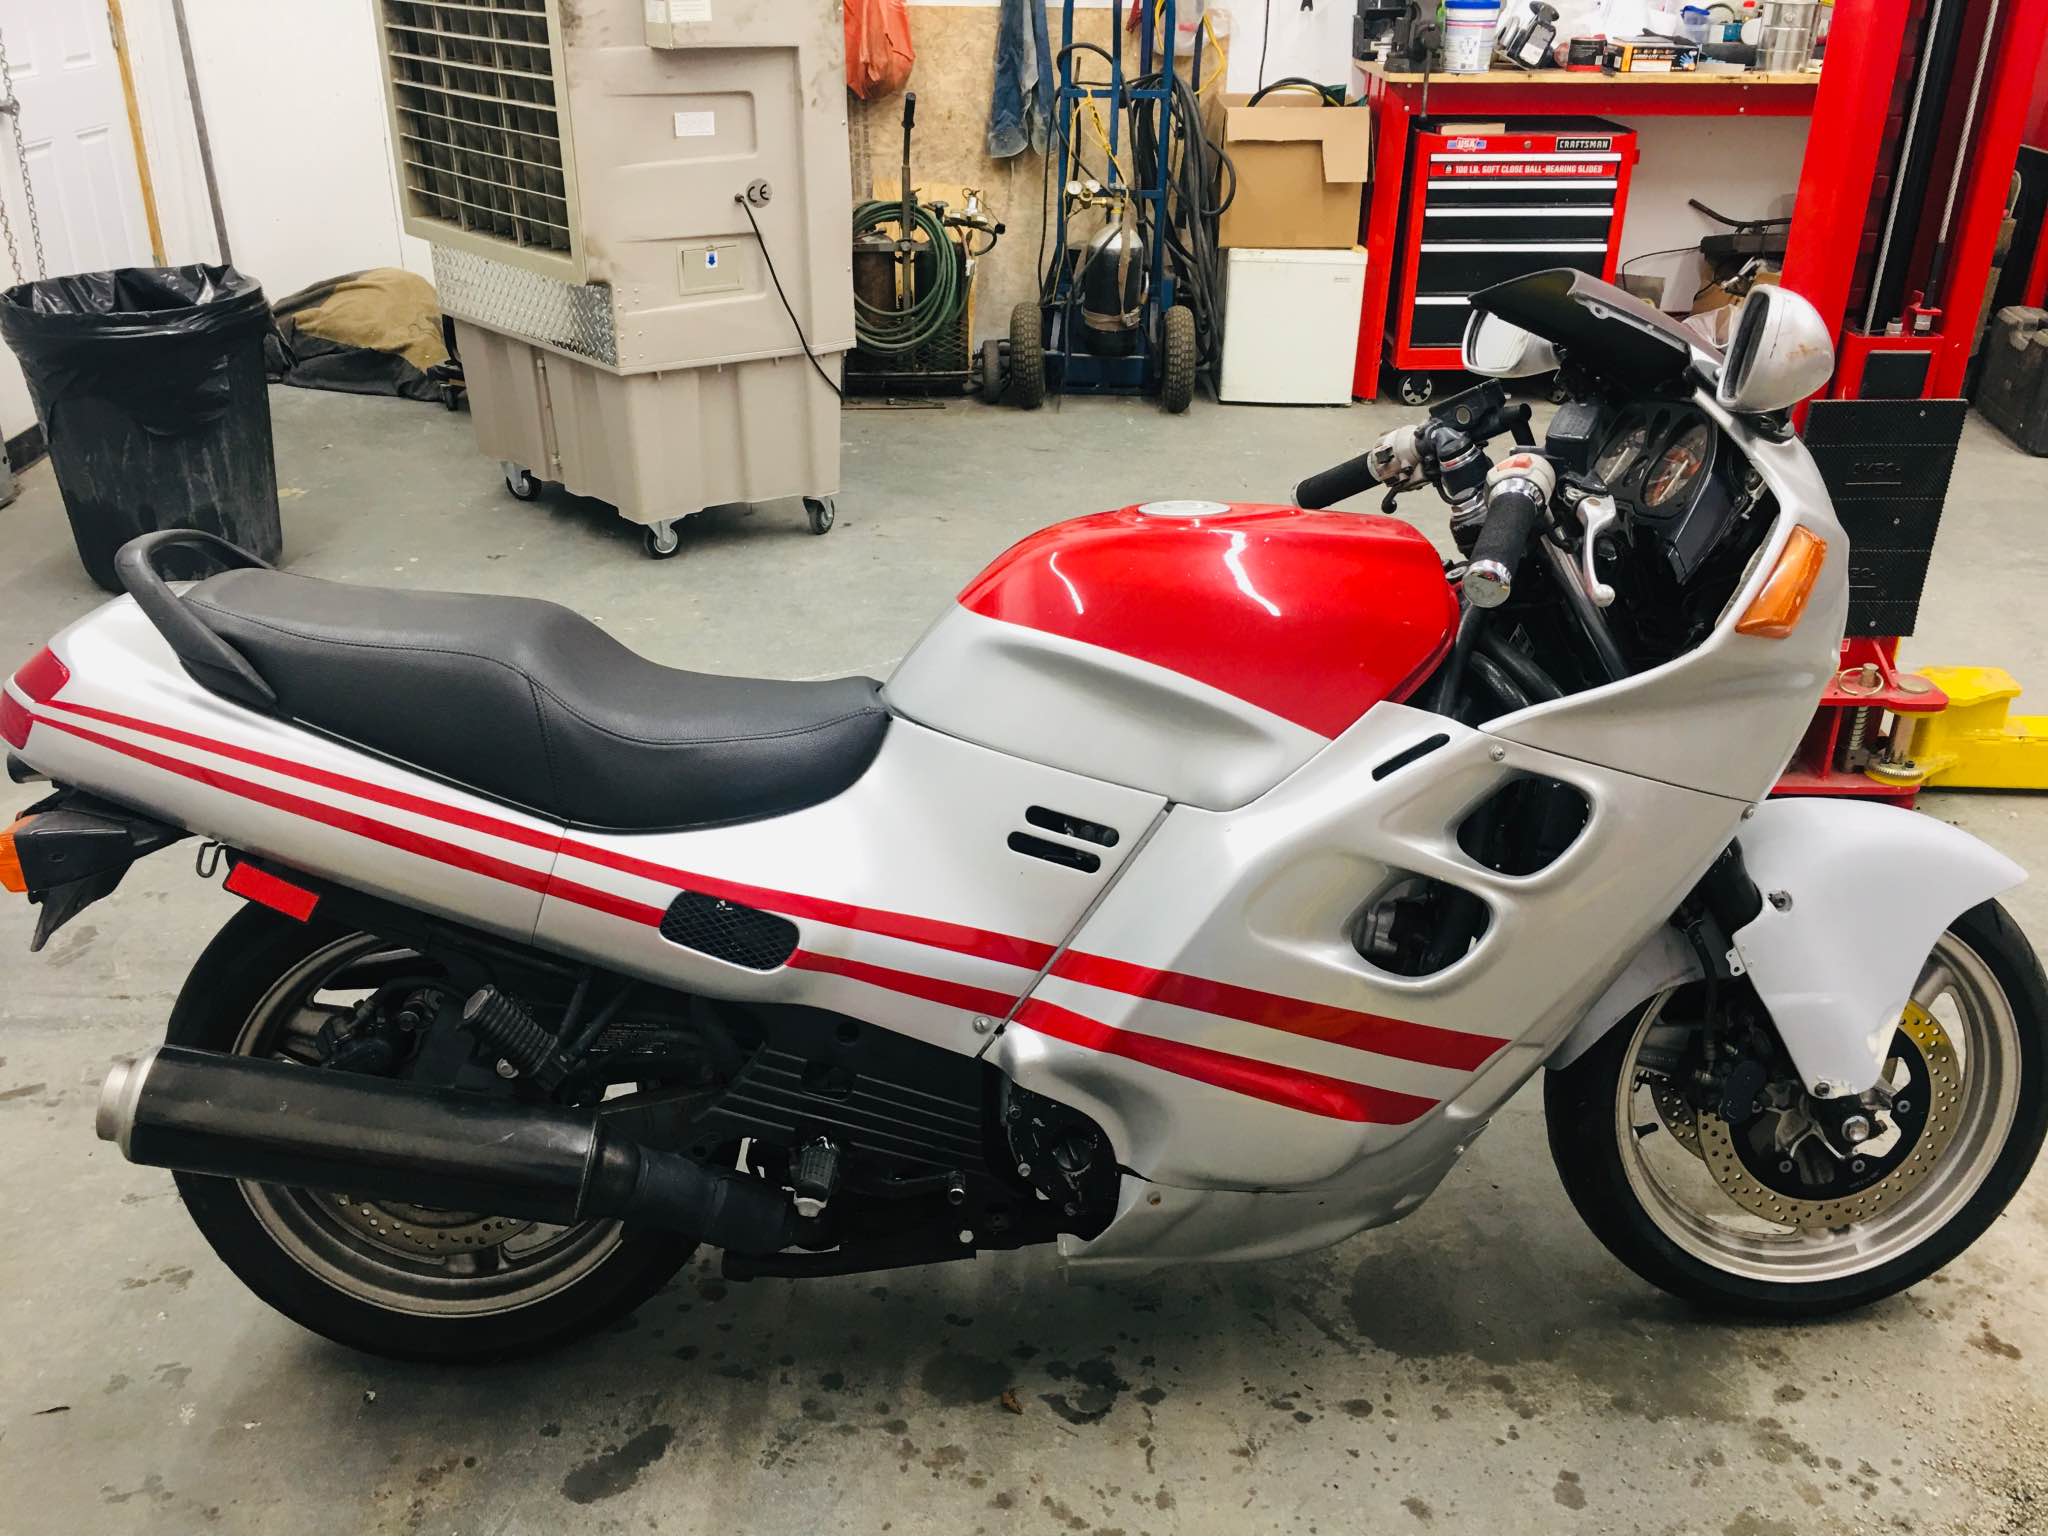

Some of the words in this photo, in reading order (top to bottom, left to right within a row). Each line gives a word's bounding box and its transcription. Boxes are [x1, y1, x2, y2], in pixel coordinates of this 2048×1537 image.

[1457, 138, 1475, 148] USA
[1559, 140, 1609, 149] CRAFTSMAN
[1456, 165, 1468, 173] 100
[1482, 165, 1501, 173] SOFT
[1501, 164, 1523, 173] CLOSE
[1525, 164, 1577, 173] BALL-BEARING
[1578, 164, 1603, 173] SLIDES
